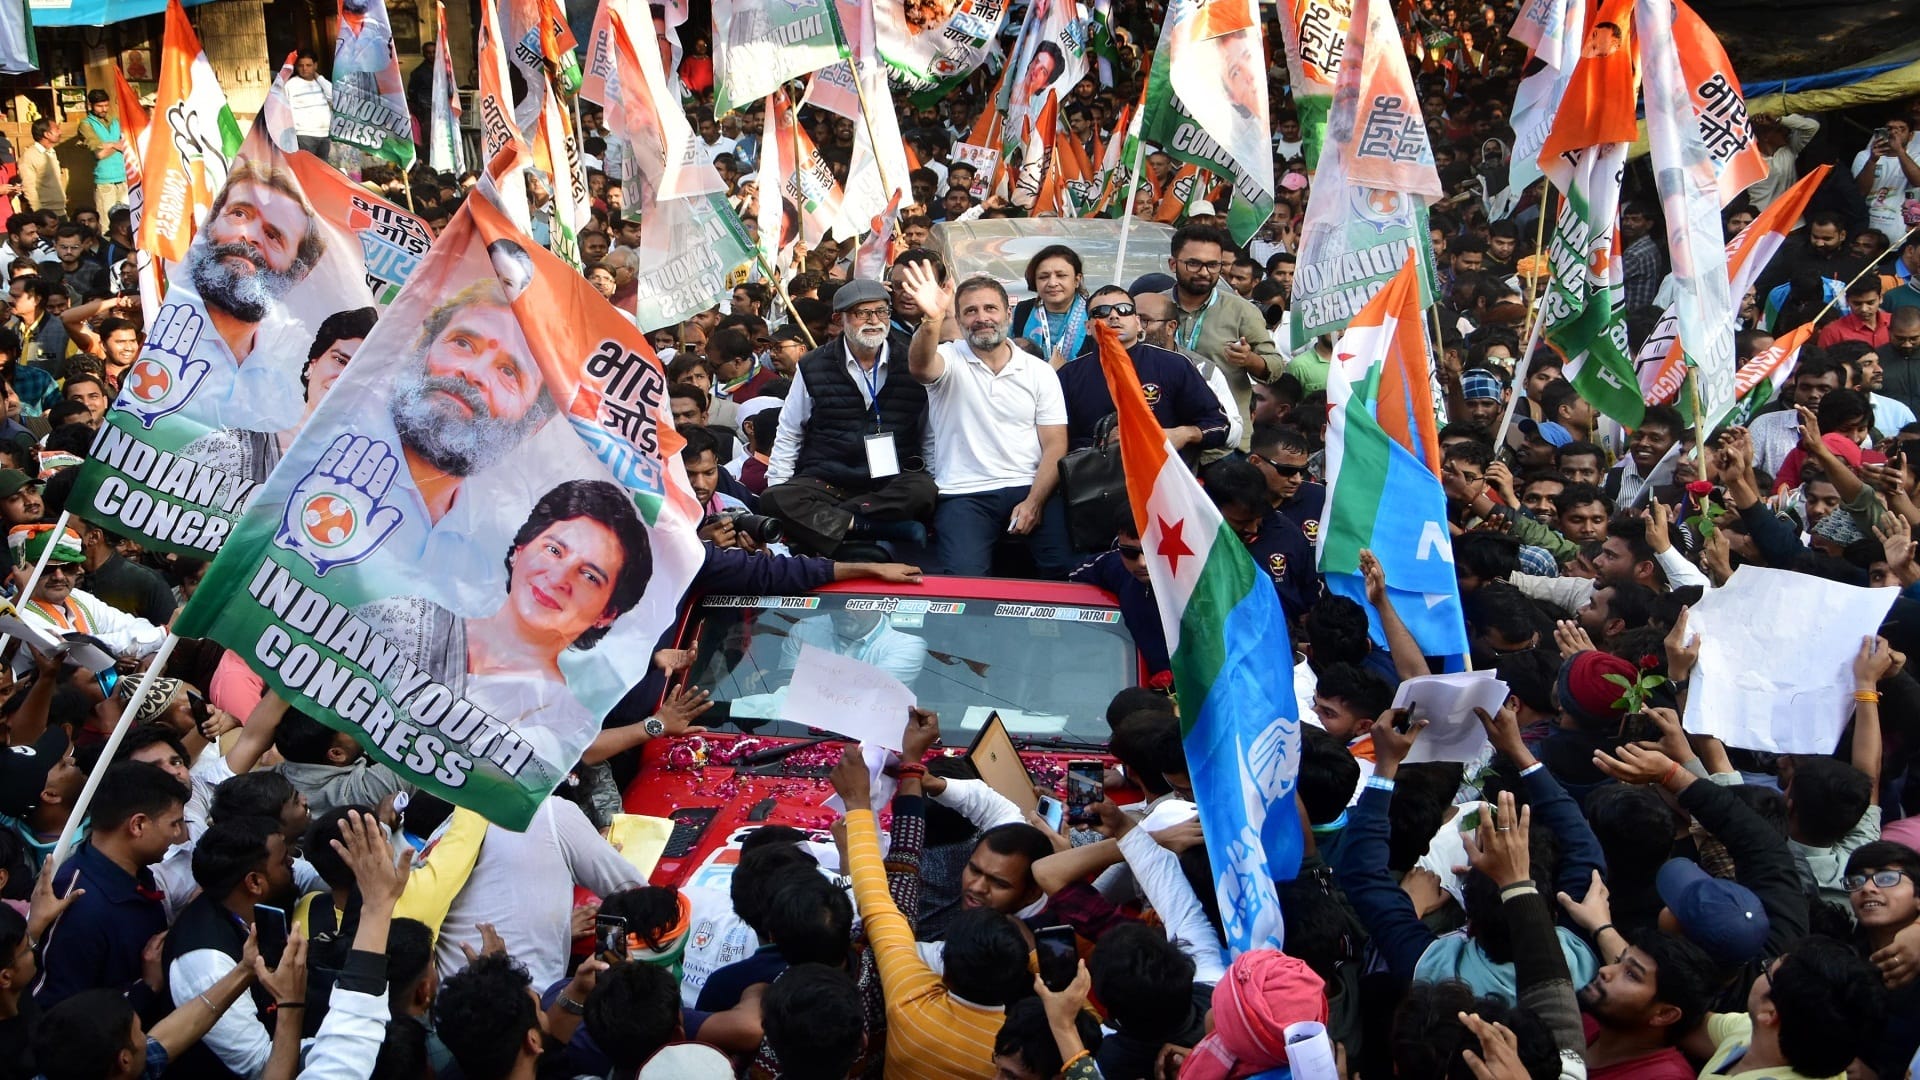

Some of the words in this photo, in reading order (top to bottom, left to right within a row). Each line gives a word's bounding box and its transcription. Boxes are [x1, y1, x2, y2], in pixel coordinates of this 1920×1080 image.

[330, 116, 388, 150] GRESS
[587, 341, 664, 407] भार
[92, 476, 240, 553] CONGR
[702, 596, 736, 607] BHARAT
[734, 596, 759, 607] JODO
[781, 596, 807, 608] YATRA
[846, 598, 873, 610] भारत
[875, 598, 899, 613] जोड़ो
[929, 602, 952, 613] यात्रा
[996, 606, 1030, 616] BHARAT
[1030, 607, 1056, 618] JODO
[1078, 611, 1105, 622] YATRA
[247, 555, 402, 680] INDIAN
[393, 658, 536, 778] YOUTH
[254, 622, 475, 790] CONGRESS
